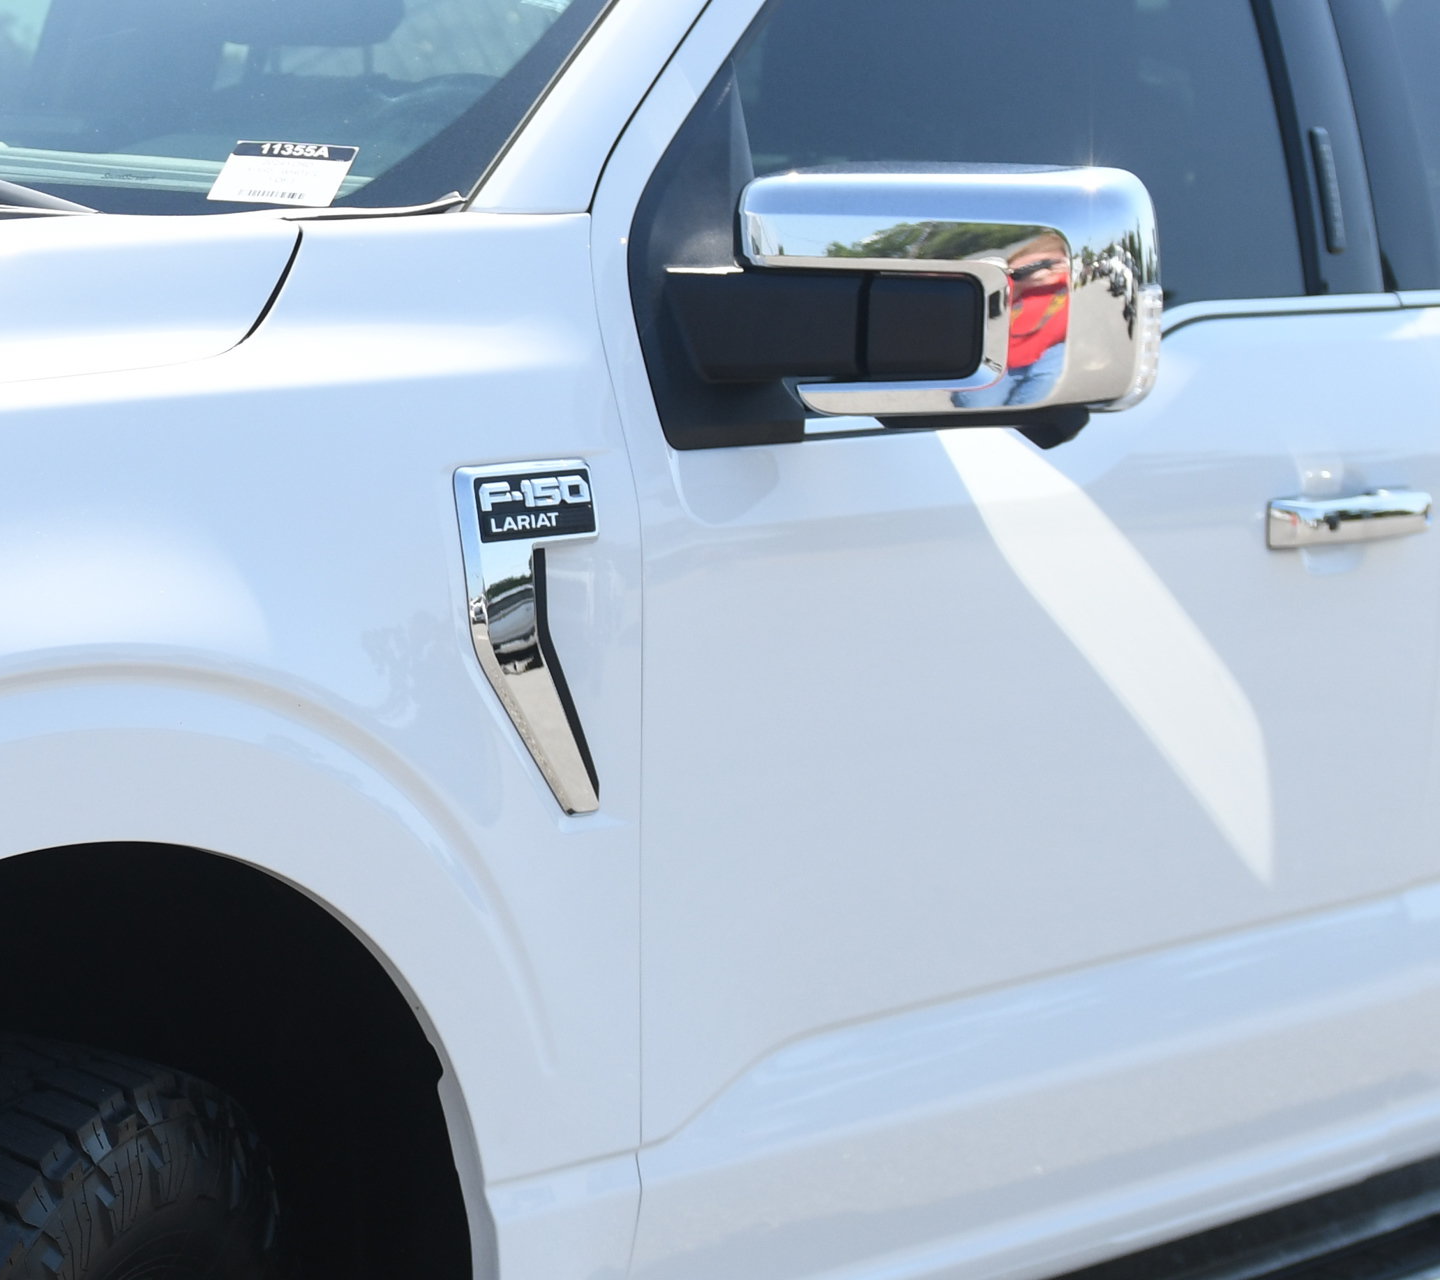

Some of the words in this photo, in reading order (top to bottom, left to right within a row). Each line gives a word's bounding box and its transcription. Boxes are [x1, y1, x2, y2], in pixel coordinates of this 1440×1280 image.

[261, 143, 329, 158] 11355A
[479, 475, 590, 512] F-150
[490, 512, 559, 533] LARIAT
